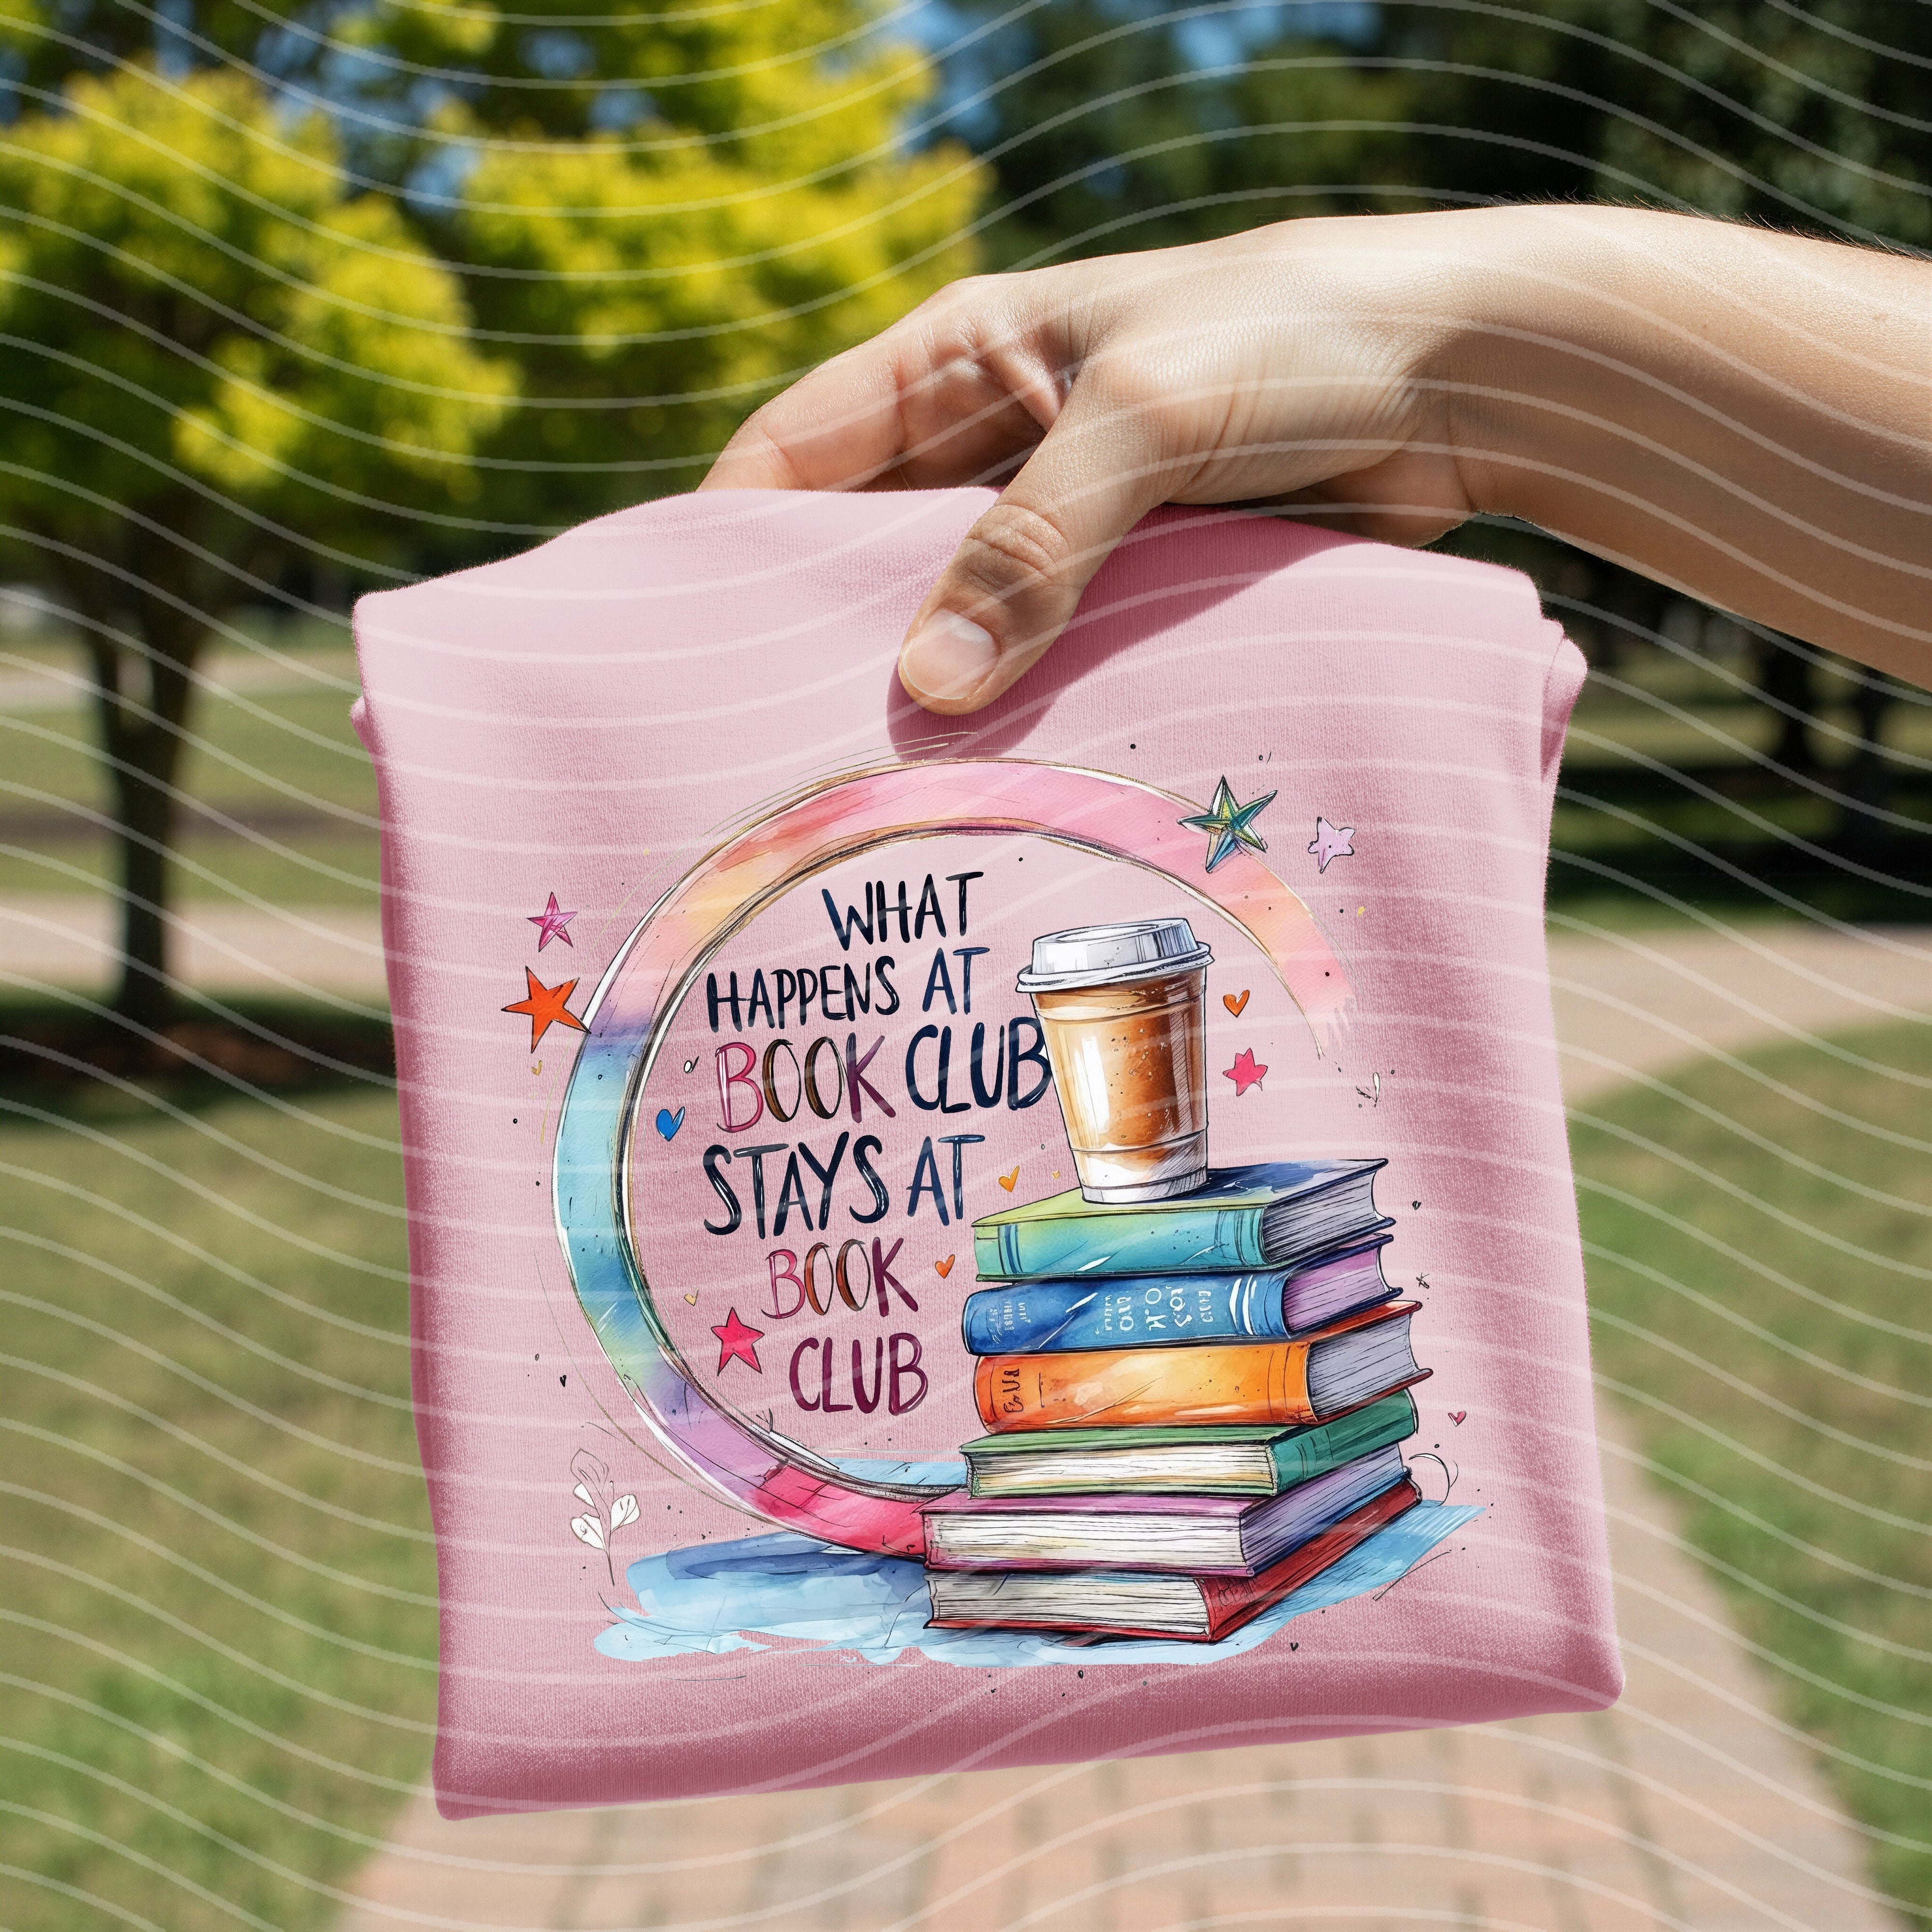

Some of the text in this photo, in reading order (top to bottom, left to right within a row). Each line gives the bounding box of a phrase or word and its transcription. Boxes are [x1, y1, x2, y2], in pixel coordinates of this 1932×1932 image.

[822, 871, 984, 951] WHAT
[706, 947, 990, 1033] HAPPENS AT
[715, 1016, 1052, 1133] BOOK CLUB
[703, 1131, 985, 1239] STAYS AT
[761, 1236, 919, 1319] BOOK
[789, 1333, 929, 1415] CLUB
